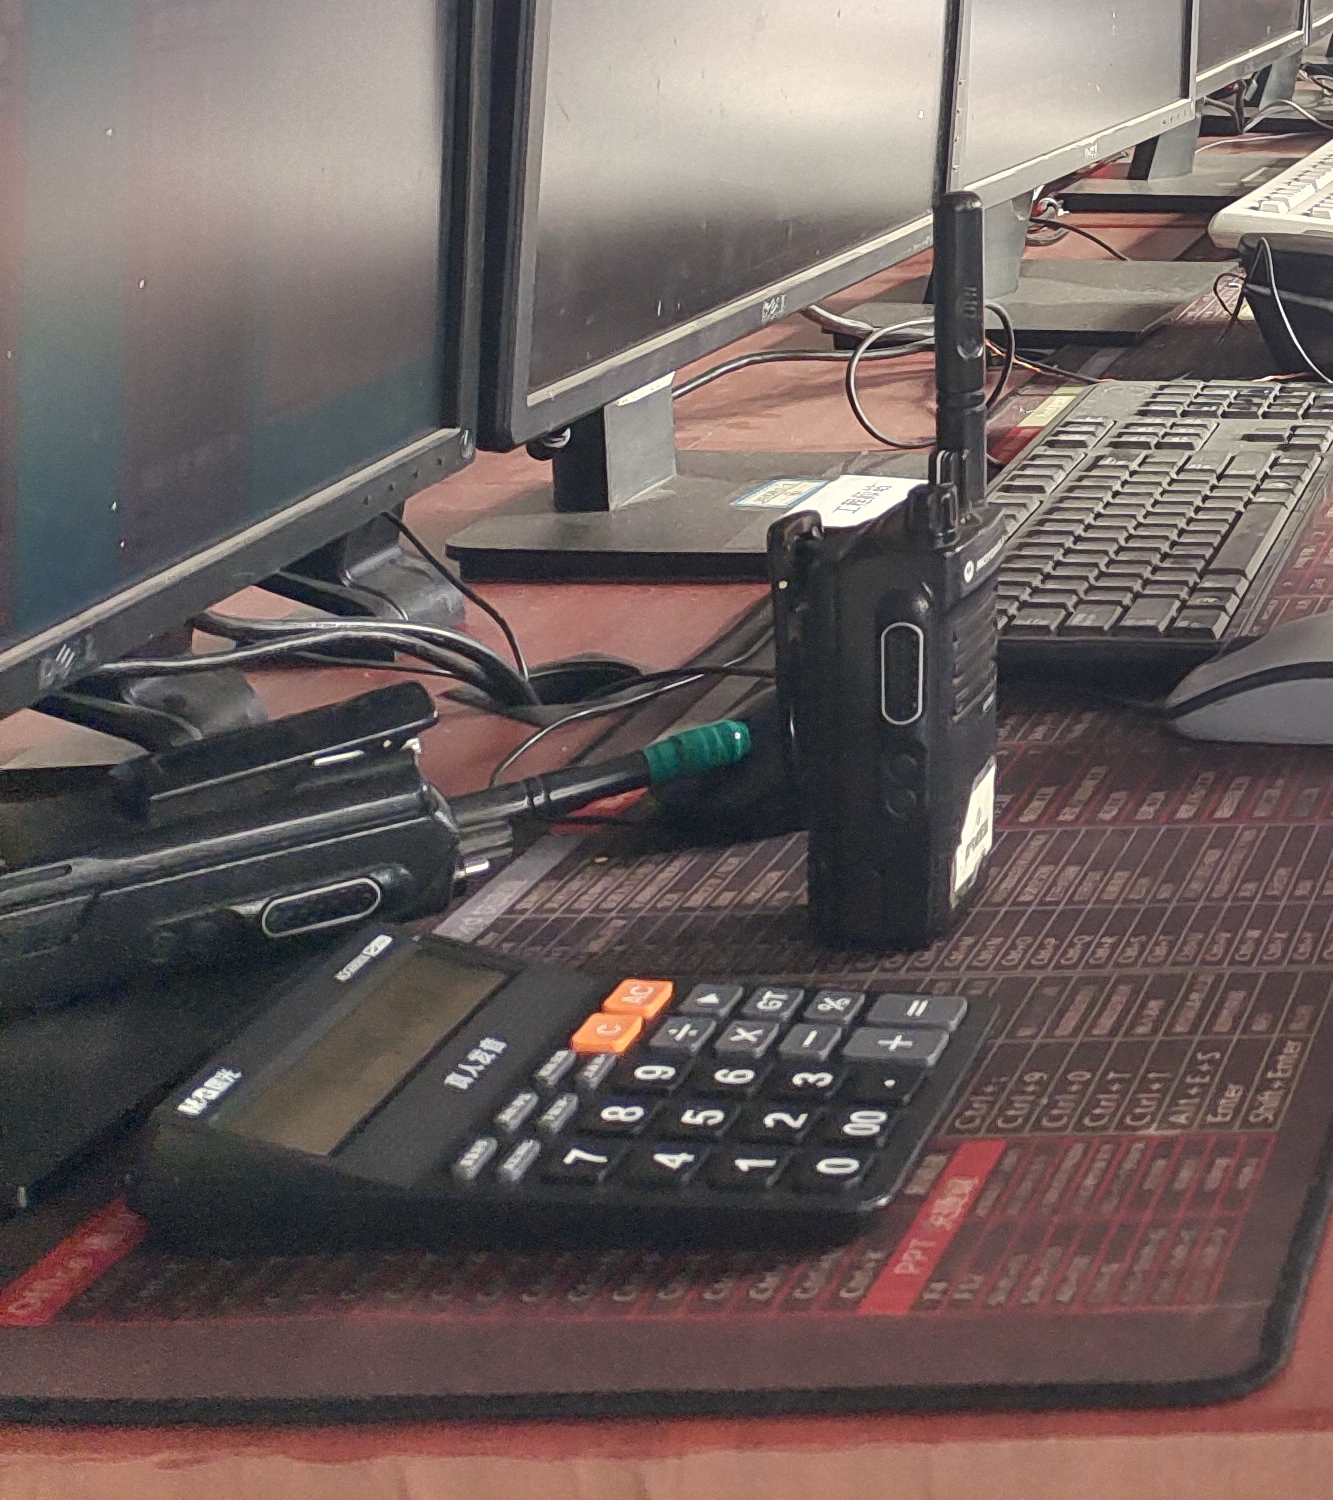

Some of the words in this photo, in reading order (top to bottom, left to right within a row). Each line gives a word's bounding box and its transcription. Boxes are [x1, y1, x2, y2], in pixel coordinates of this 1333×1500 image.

[634, 1064, 677, 1083] 9
[714, 1069, 756, 1086] 6
[794, 1070, 832, 1089] 3
[1250, 1040, 1302, 1123] Shift+Enter
[1209, 1083, 1243, 1123] Enter
[601, 1106, 644, 1122] 8
[682, 1109, 724, 1126] 5
[766, 1111, 808, 1129] 2
[842, 1111, 888, 1135] 00
[563, 1149, 608, 1166] 7
[653, 1152, 695, 1171] 4
[736, 1157, 777, 1173] 1
[817, 1158, 858, 1175] 0
[894, 1241, 937, 1275] PPT
